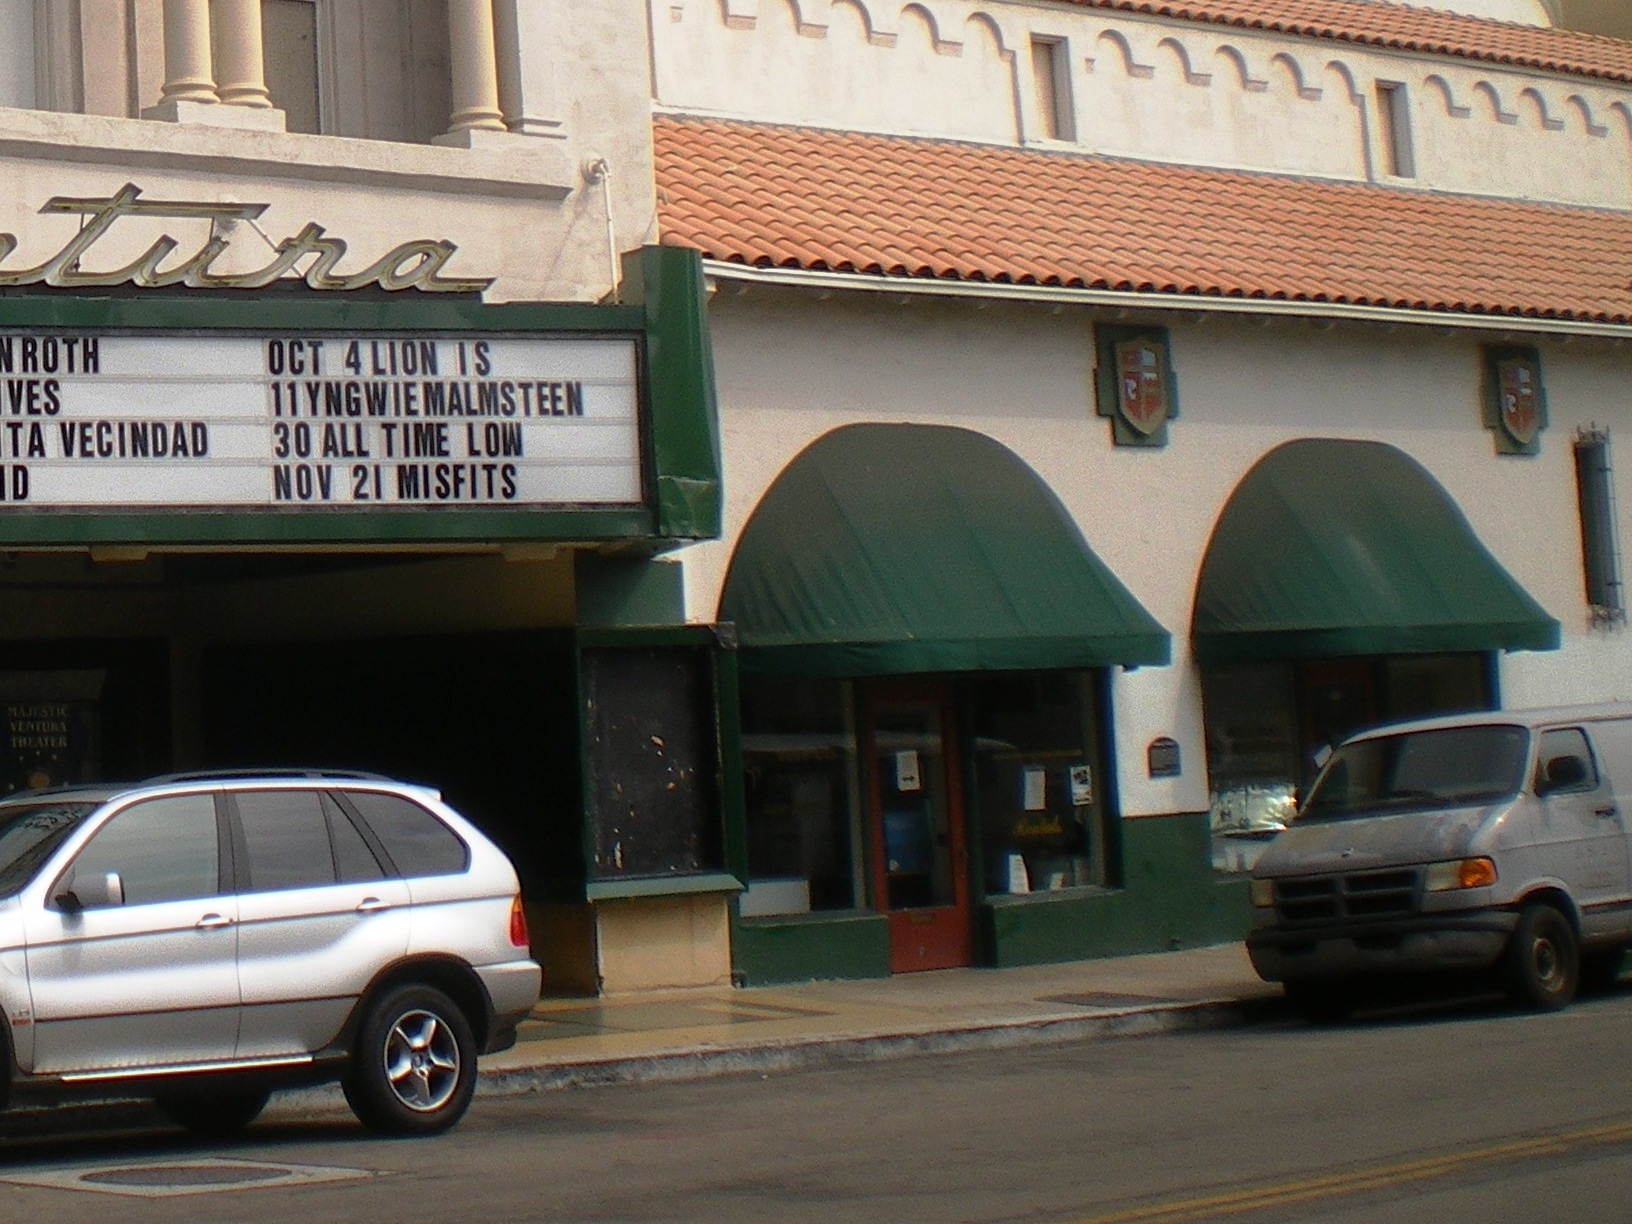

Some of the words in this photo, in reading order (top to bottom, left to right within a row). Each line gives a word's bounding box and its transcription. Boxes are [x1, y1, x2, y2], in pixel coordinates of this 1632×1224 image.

[21, 336, 100, 374] ROTH
[268, 338, 324, 376] OCT
[344, 340, 362, 376] 4
[370, 340, 438, 376] LION
[458, 340, 492, 376] IS
[270, 381, 299, 418] 11
[305, 381, 419, 418] YNGWIE
[422, 381, 585, 418] MALMSTEEN
[58, 419, 209, 459] VECINDAD
[273, 421, 311, 459] 30
[322, 422, 371, 459] ALL
[380, 422, 450, 459] TIME
[467, 422, 524, 459] LOW
[273, 464, 333, 501] NOV
[352, 464, 384, 500] 21
[396, 463, 517, 500] MISFITS
[8, 706, 67, 717] MAJESTIC
[10, 721, 67, 732] VENTURA
[11, 736, 68, 748] THEATER
